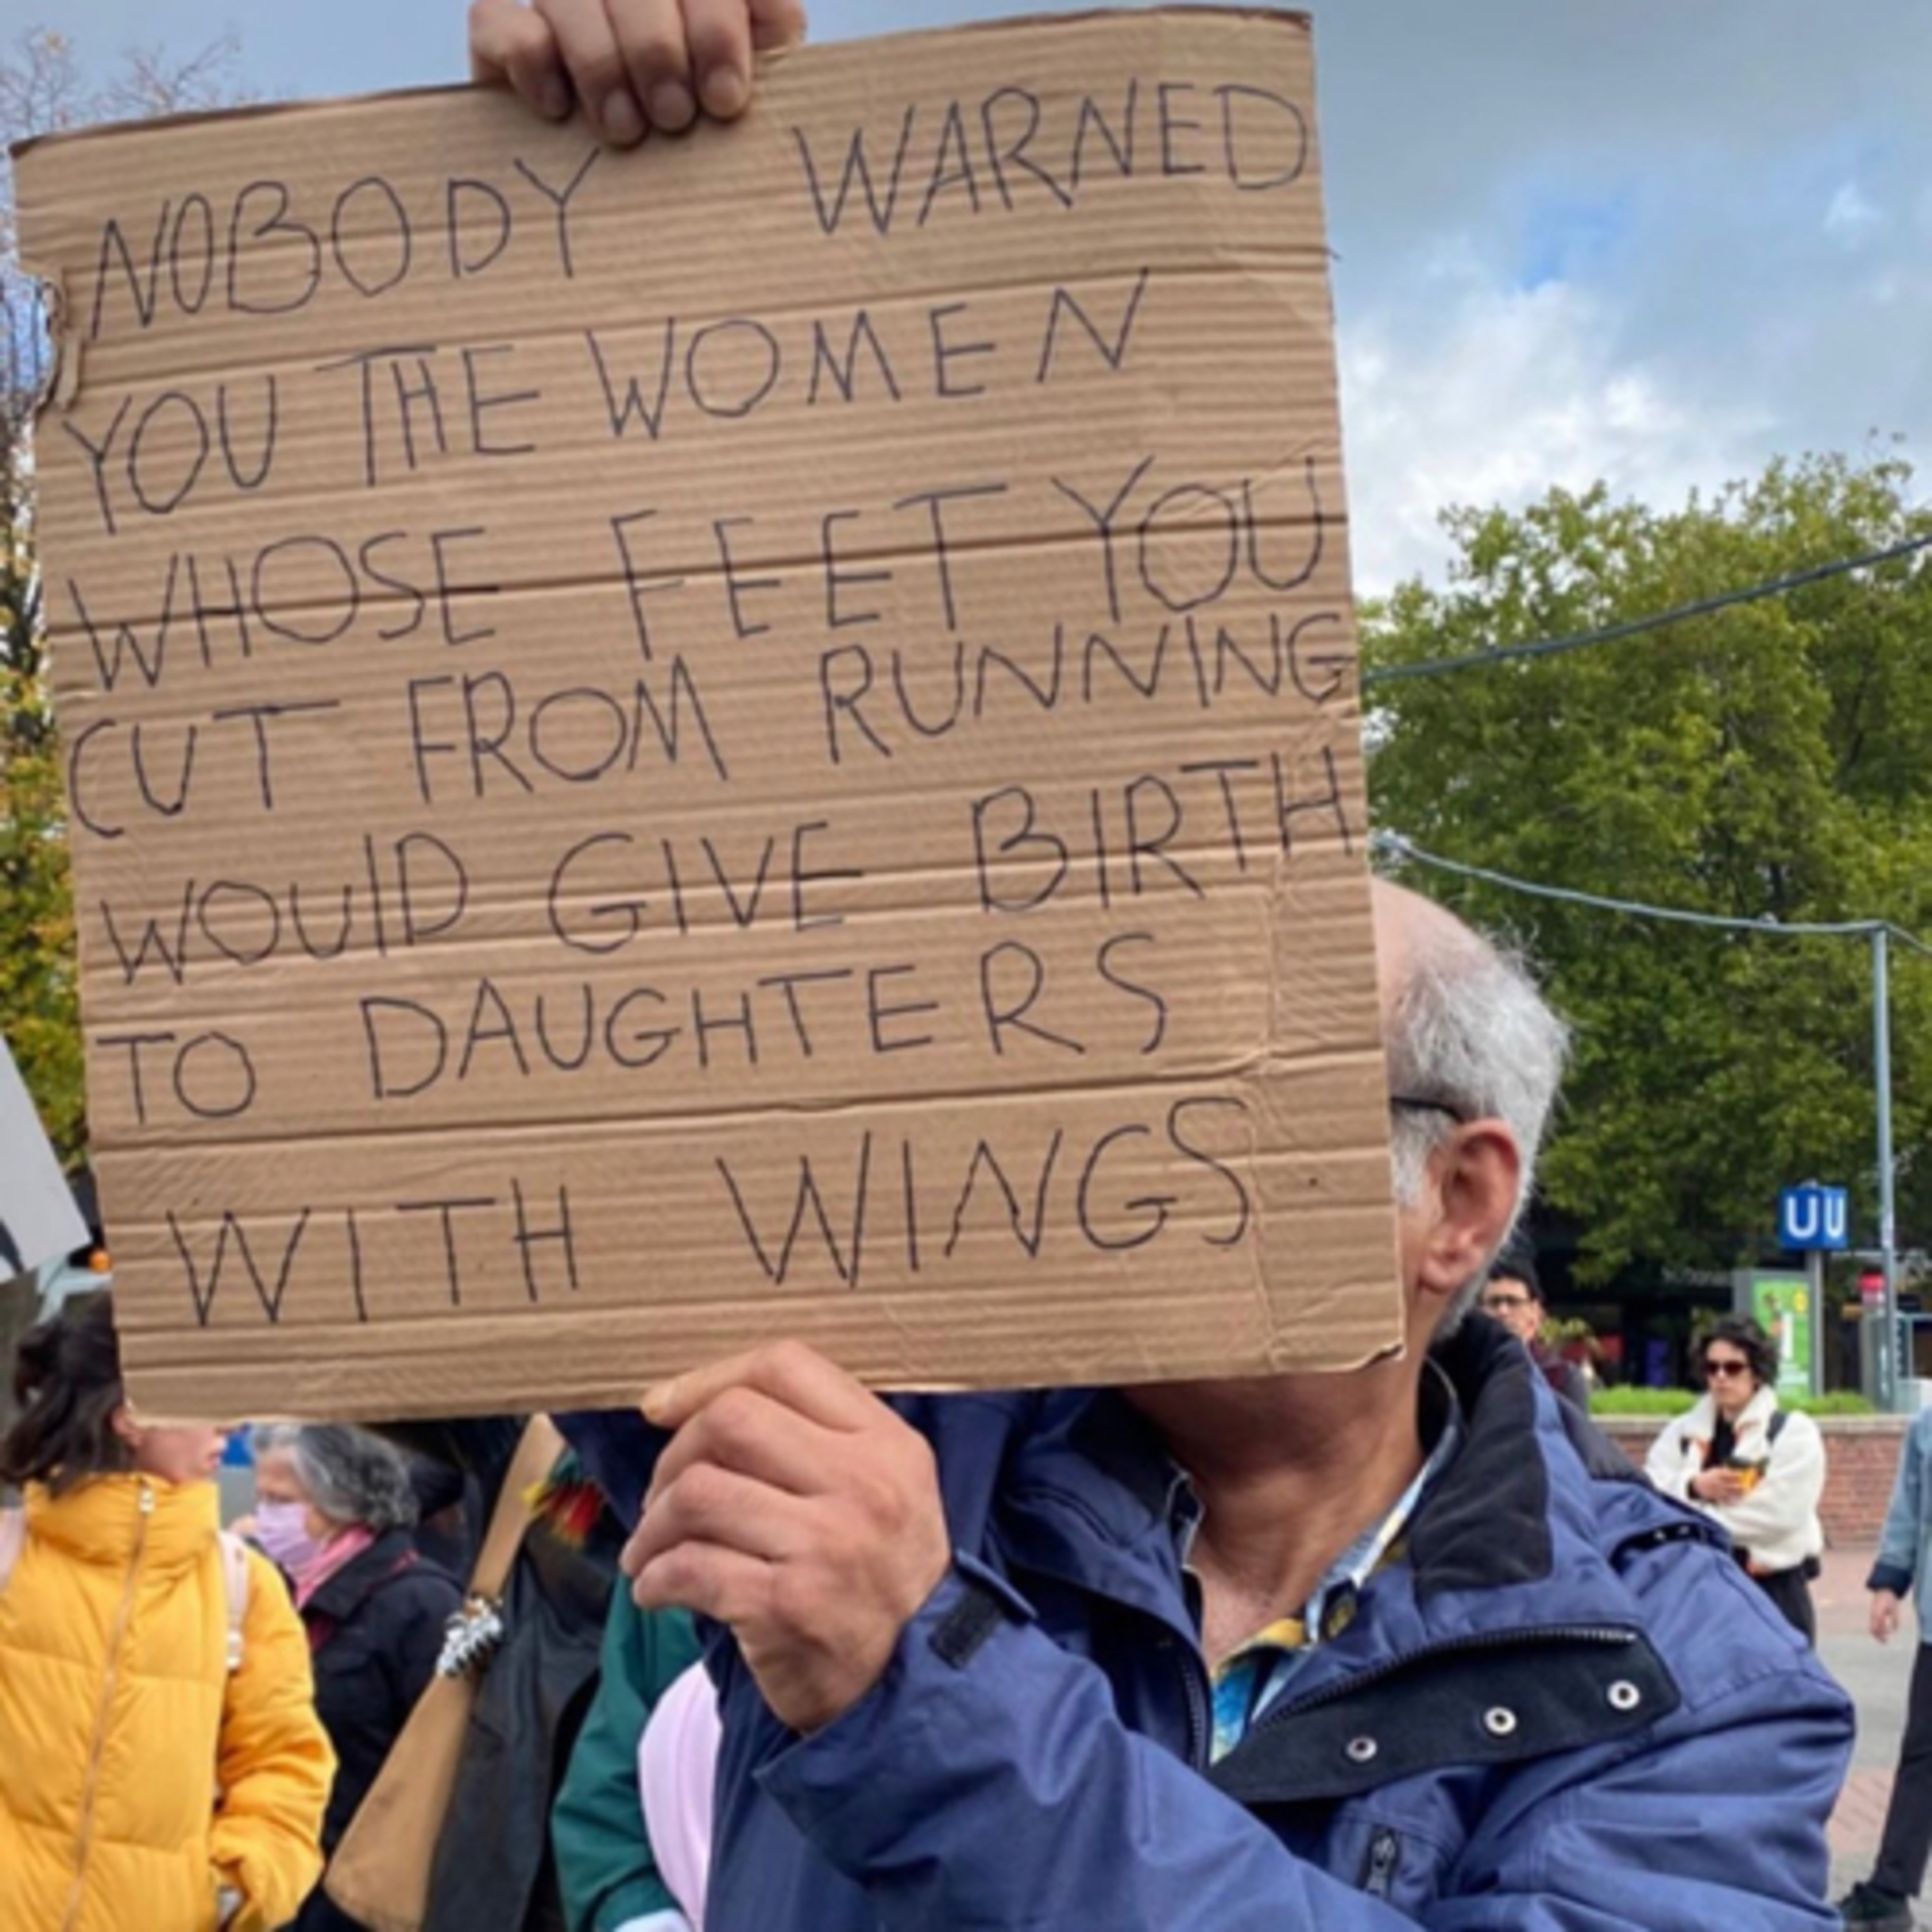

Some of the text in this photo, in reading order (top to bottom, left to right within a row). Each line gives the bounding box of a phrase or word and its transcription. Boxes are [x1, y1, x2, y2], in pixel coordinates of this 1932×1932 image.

[90, 77, 1309, 339] NOBODY WARNED
[62, 268, 1148, 535] YOU THE WOMEN
[68, 455, 1323, 692] WHOSE FEET YOU
[68, 612, 1354, 838] CUT FROM RUNNING
[547, 820, 864, 954] GIVE
[971, 744, 1354, 914] BIRTH
[96, 932, 1169, 1124] TO DAUGHTERS
[166, 1096, 1251, 1328] WITH WINGS
[1785, 1195, 1819, 1239] U
[1824, 1195, 1846, 1239] U
